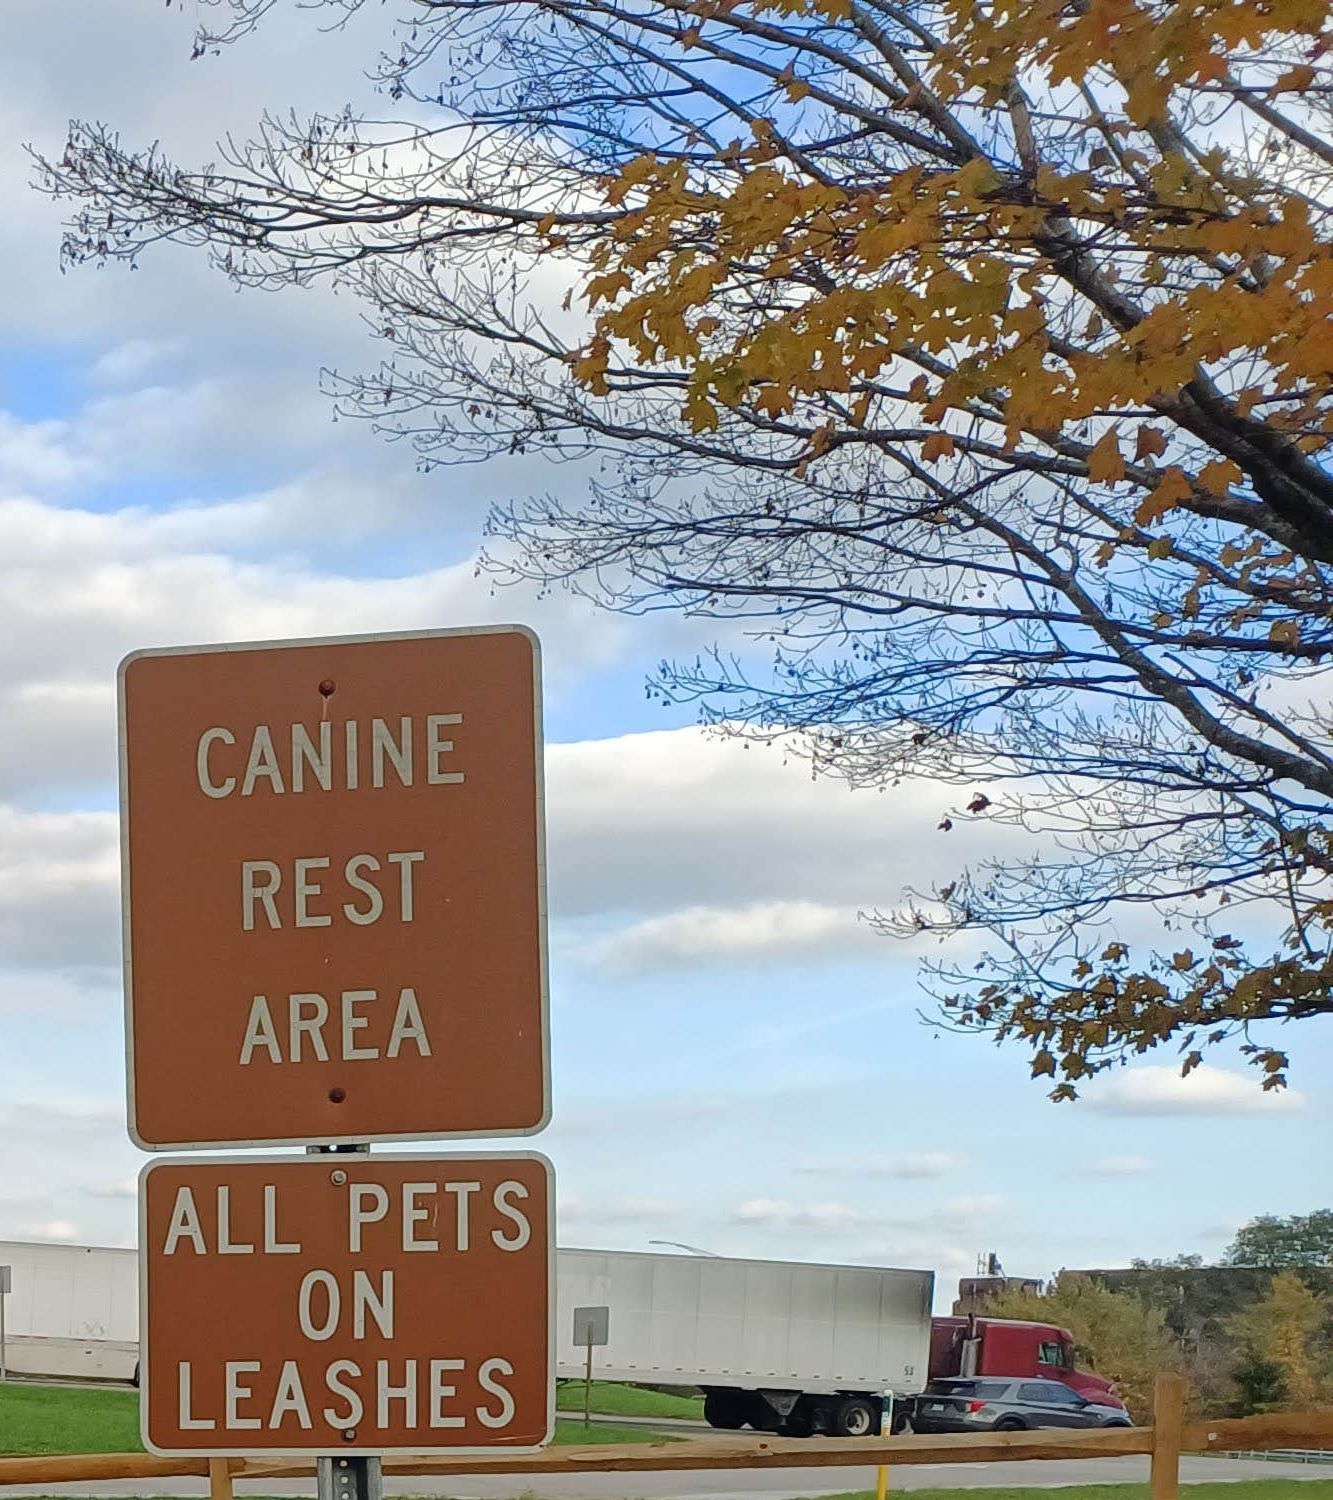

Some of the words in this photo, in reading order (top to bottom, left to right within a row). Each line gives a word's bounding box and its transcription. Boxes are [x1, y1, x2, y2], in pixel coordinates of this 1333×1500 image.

[196, 713, 465, 799] CANINE
[242, 851, 425, 930] REST
[239, 988, 432, 1065] AREA
[163, 1185, 301, 1255] ALL
[349, 1180, 531, 1253] PETS
[298, 1269, 394, 1341] ON
[179, 1357, 515, 1430] LEASHES
